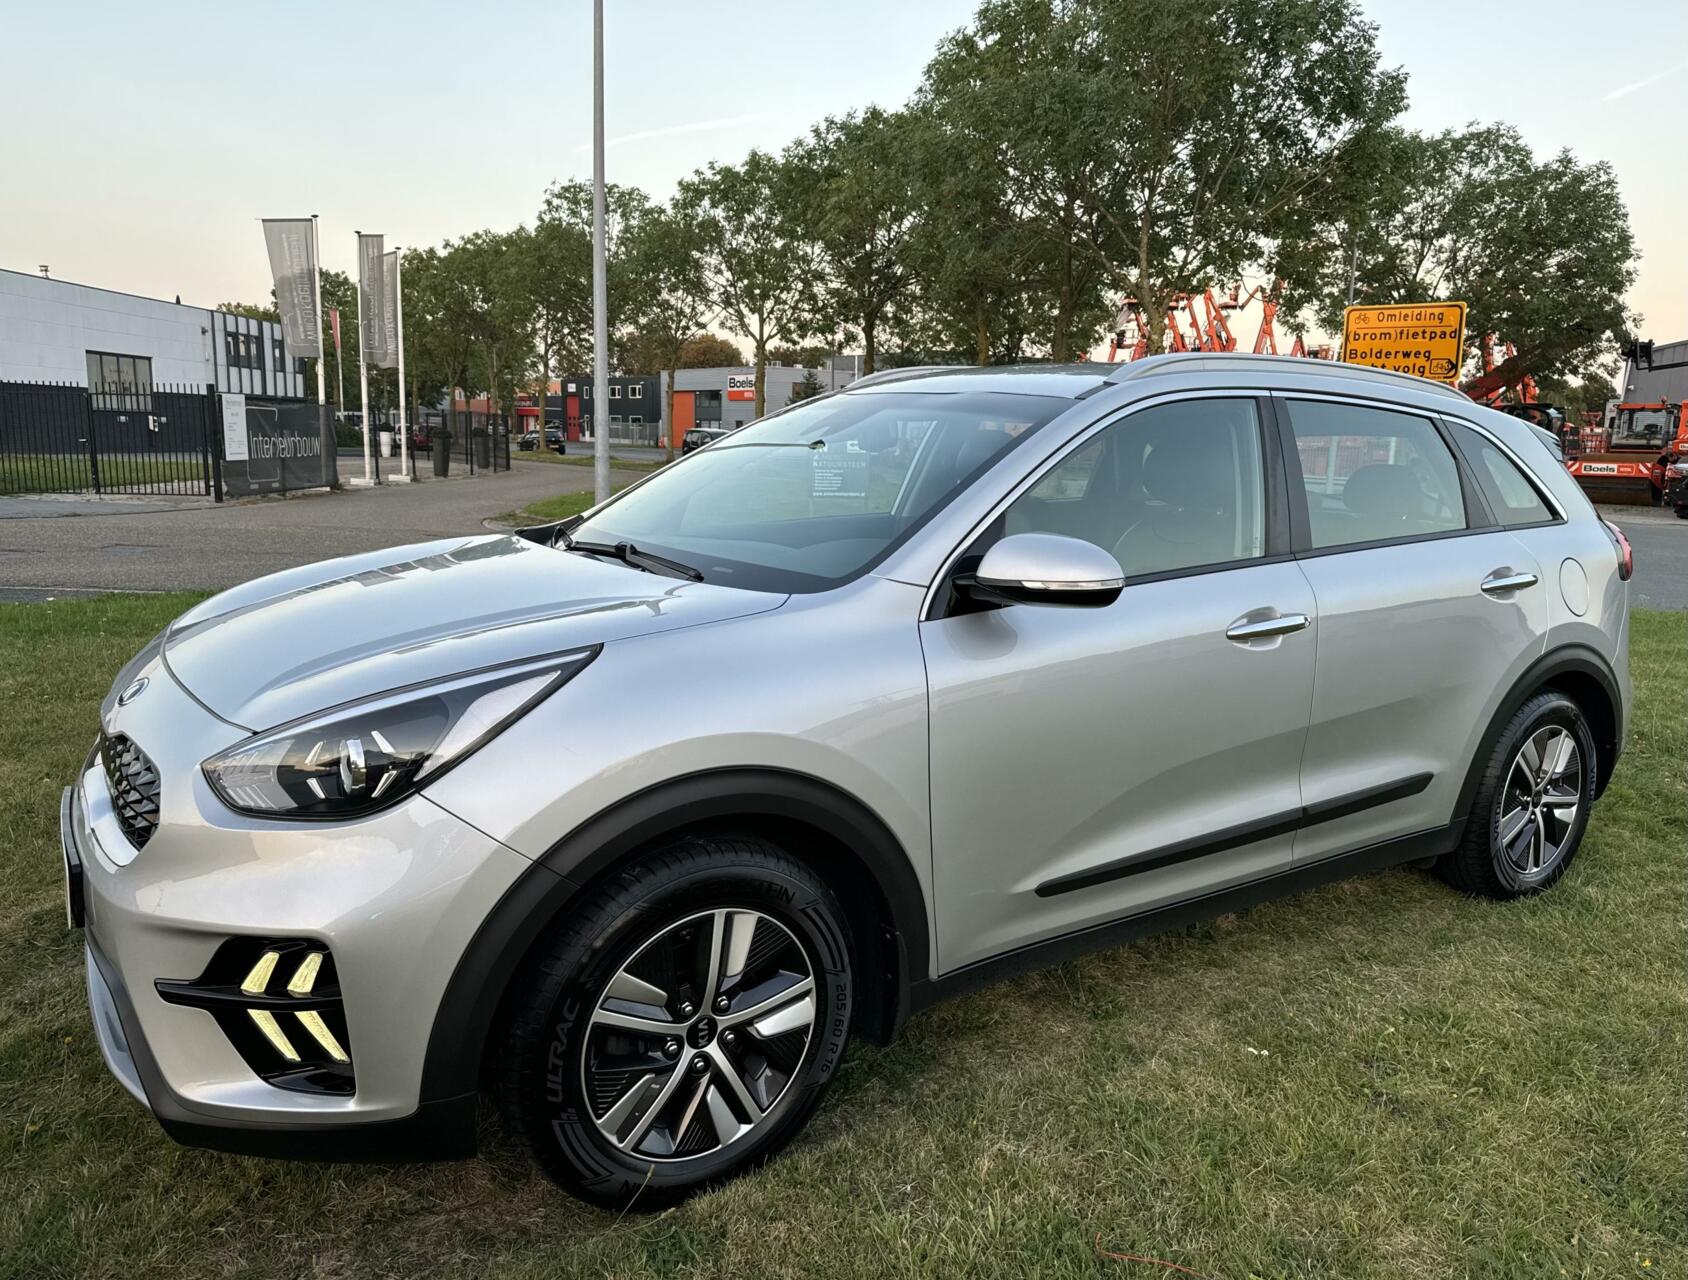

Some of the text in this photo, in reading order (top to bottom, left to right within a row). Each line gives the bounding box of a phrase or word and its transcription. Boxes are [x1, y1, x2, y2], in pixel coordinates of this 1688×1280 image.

[1377, 311, 1444, 323] Omleiding
[1347, 328, 1457, 344] (brom)fietpad
[1349, 348, 1431, 361] Bolderweg
[1393, 363, 1426, 377] volg
[729, 377, 753, 388] Boels
[249, 430, 321, 460] Interieurbouw
[1583, 465, 1615, 473] Boels
[697, 1018, 709, 1047] KIA
[820, 983, 847, 1075] 205/60 R 16
[546, 998, 581, 1103] ULTRAC
